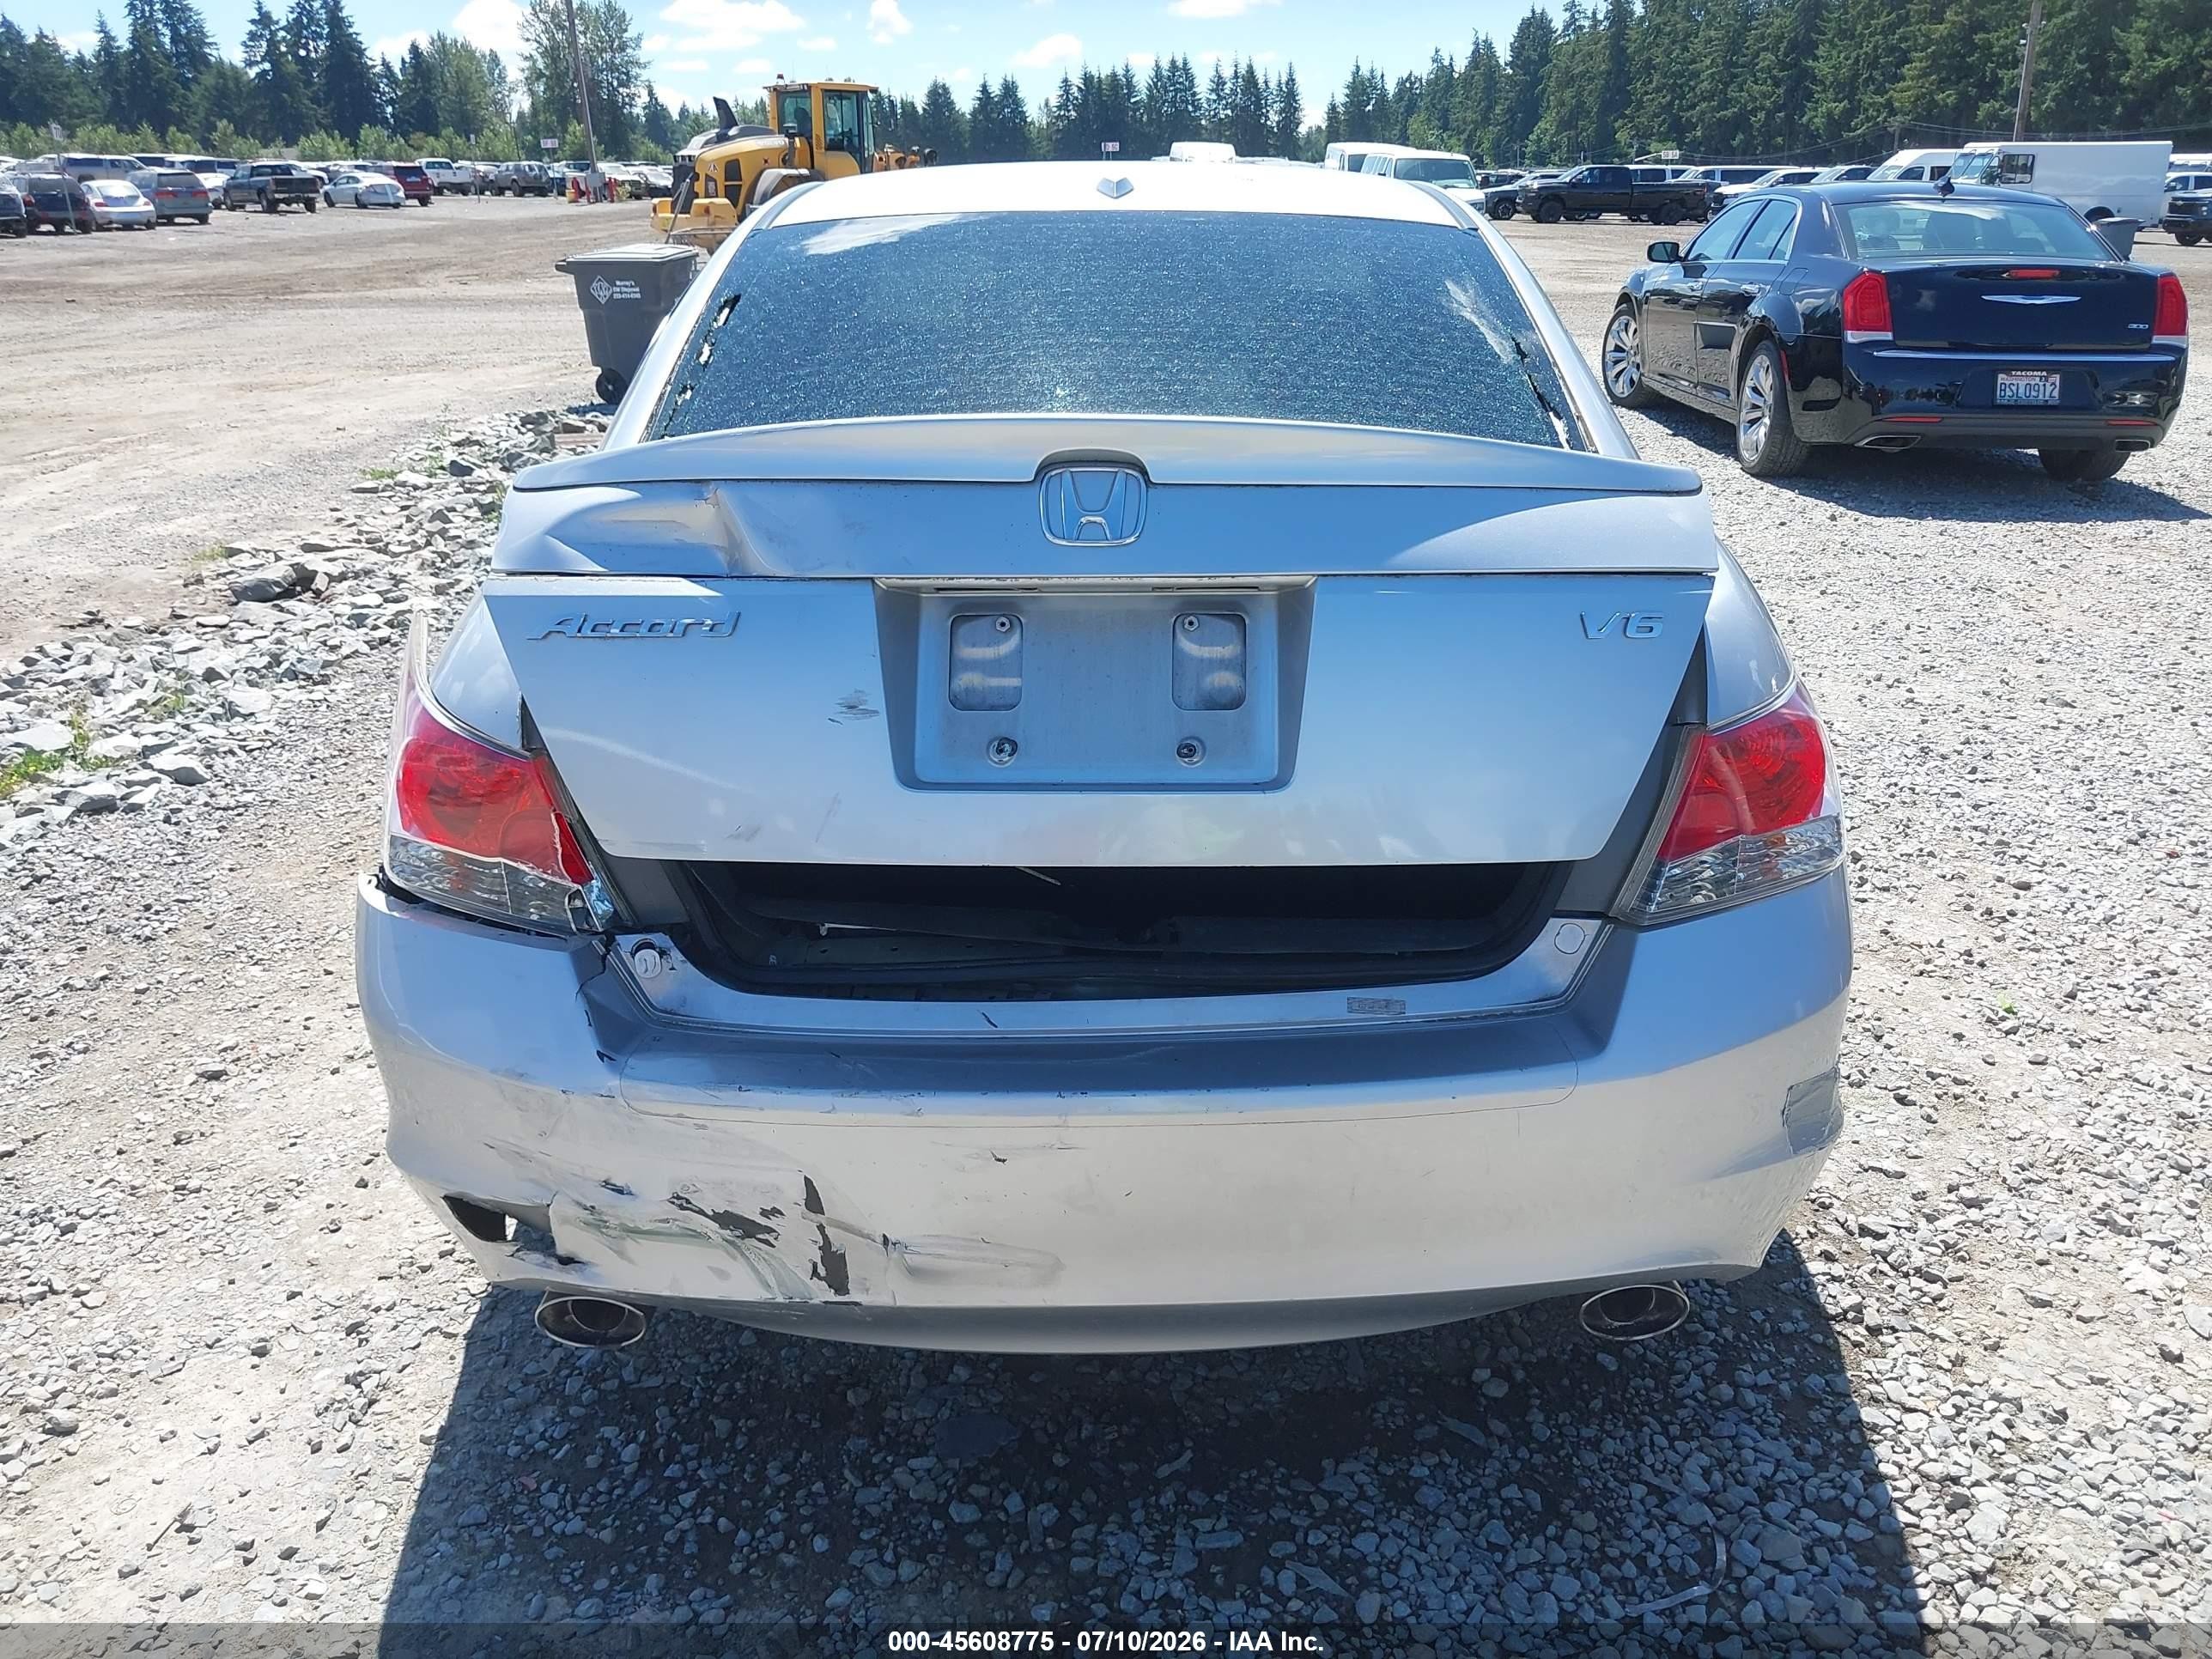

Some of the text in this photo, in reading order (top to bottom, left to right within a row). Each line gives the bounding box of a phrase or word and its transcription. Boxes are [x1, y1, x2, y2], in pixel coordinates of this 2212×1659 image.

[1999, 382, 2057, 399] BSL0912
[526, 611, 742, 641] Accord
[1580, 611, 1664, 640] V6
